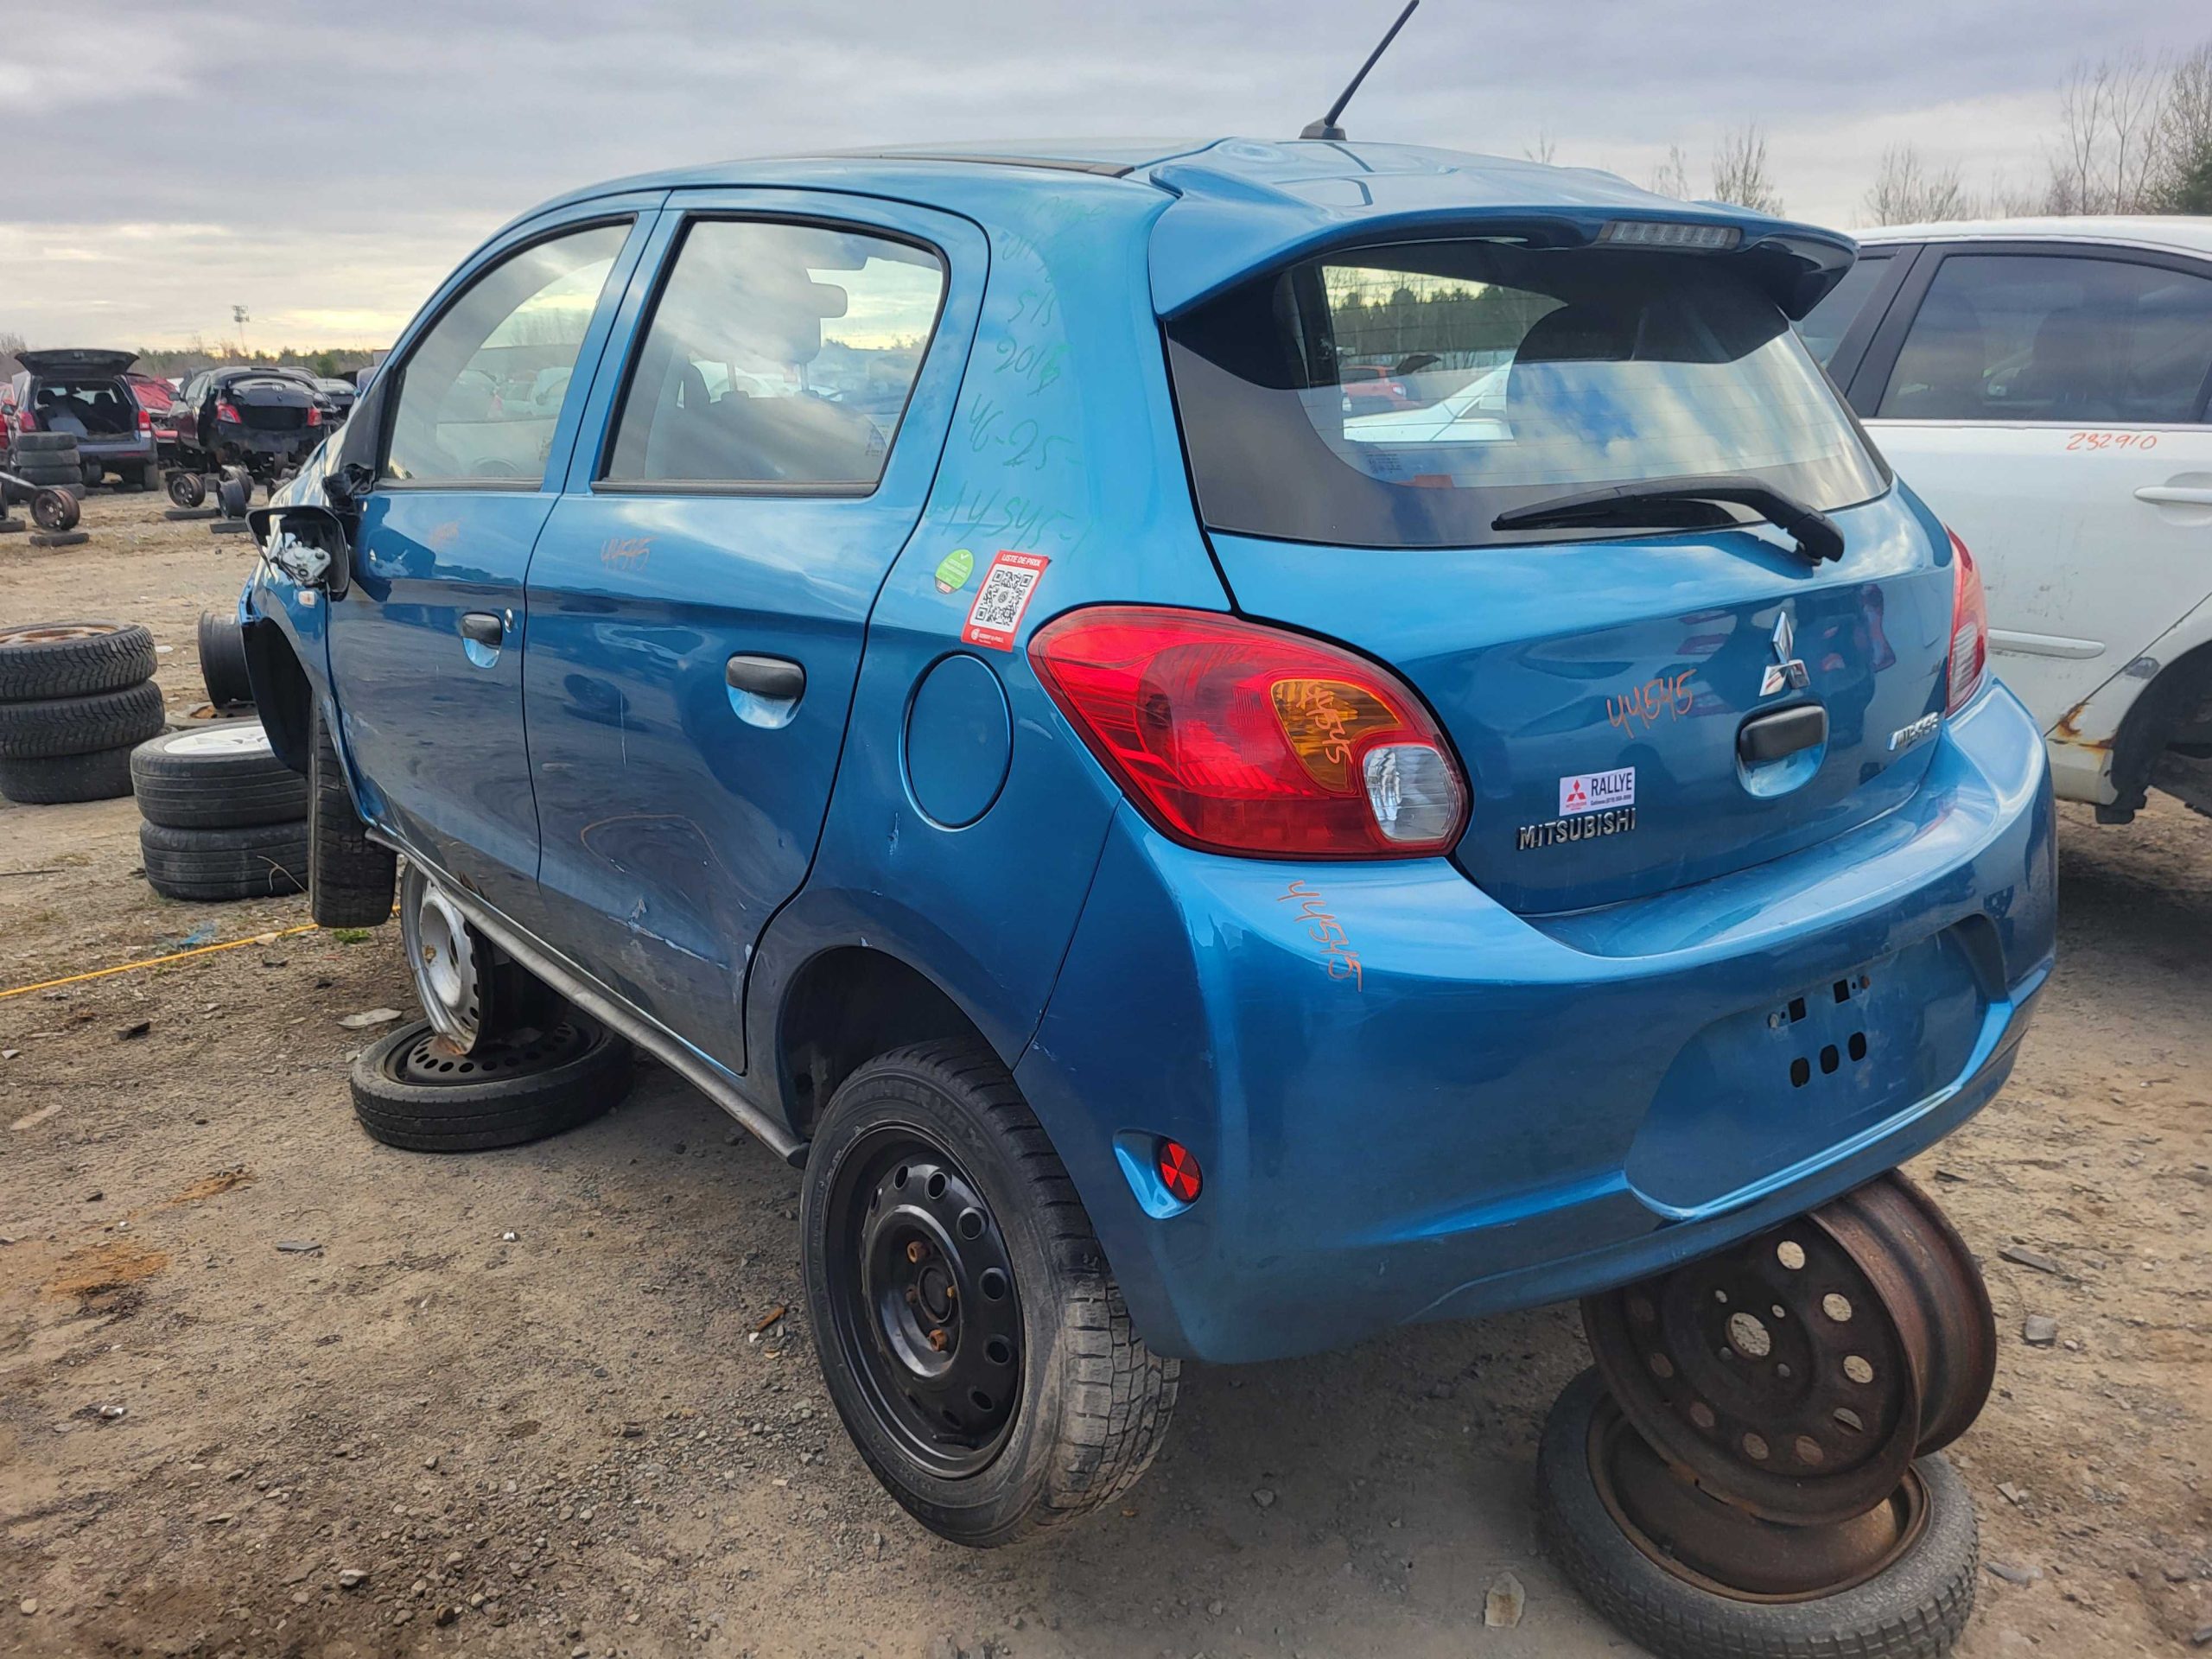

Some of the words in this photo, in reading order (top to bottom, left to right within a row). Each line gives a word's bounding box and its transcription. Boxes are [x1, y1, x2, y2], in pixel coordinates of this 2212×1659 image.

[2065, 432, 2158, 451] 232910
[1606, 669, 1698, 740] 44545
[1591, 772, 1632, 797] RALLYE
[1518, 808, 1637, 851] MITSUBISHI
[1277, 880, 1363, 993] 44545
